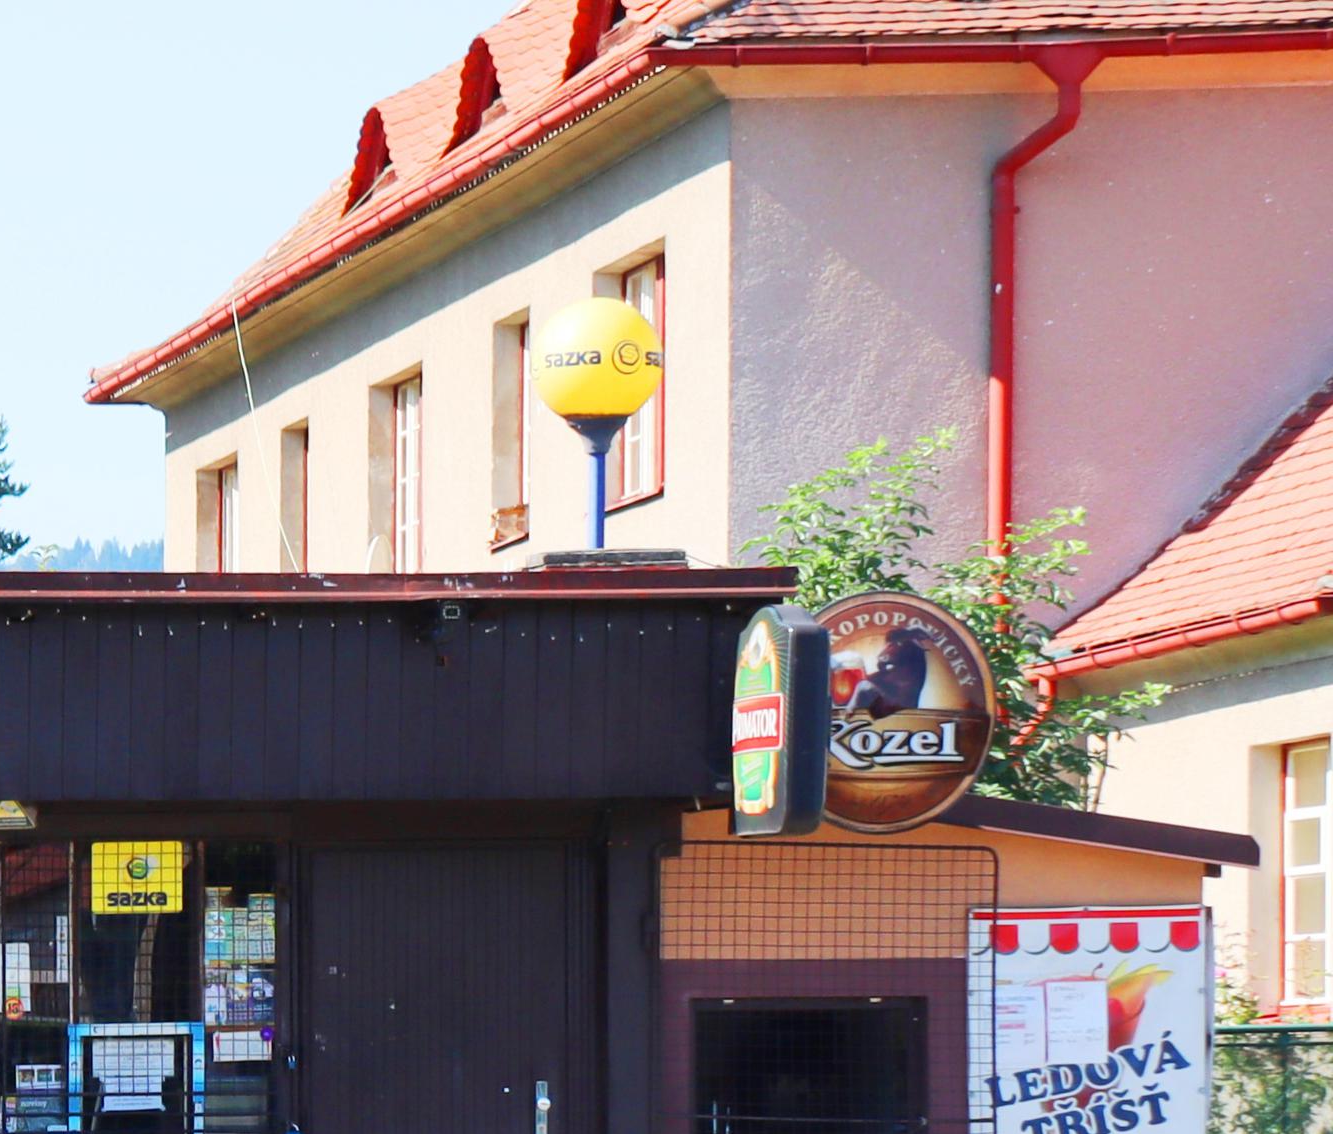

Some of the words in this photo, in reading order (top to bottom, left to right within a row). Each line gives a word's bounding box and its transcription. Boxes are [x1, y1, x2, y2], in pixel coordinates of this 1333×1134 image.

[544, 350, 602, 369] sazka
[107, 891, 167, 908] sazka
[984, 1030, 1191, 1108] LEDOVÁ
